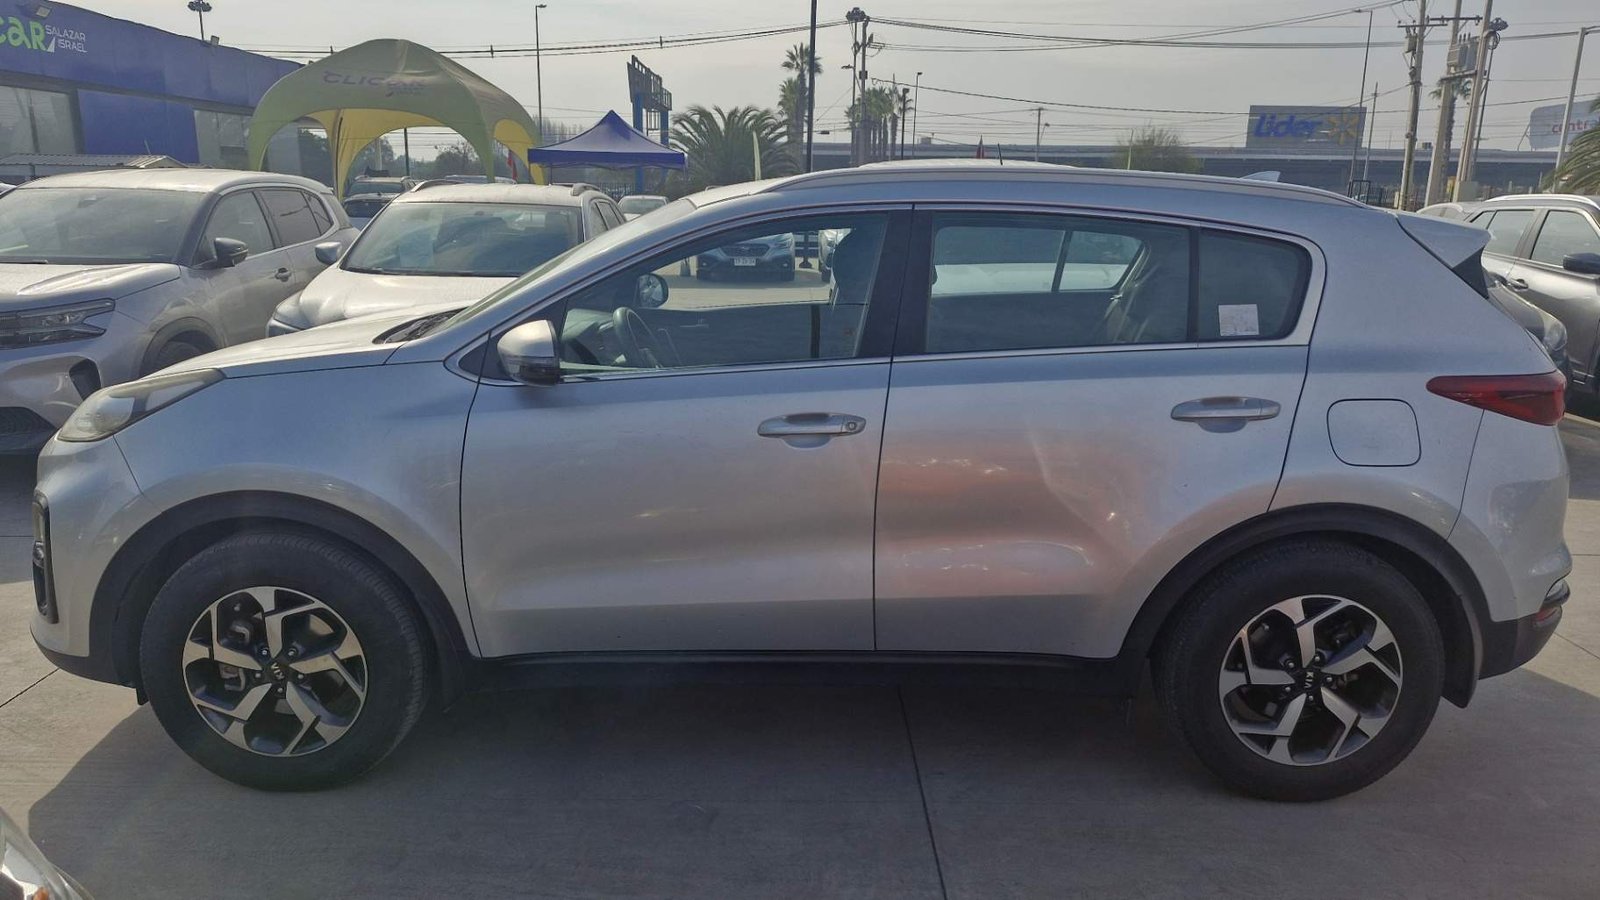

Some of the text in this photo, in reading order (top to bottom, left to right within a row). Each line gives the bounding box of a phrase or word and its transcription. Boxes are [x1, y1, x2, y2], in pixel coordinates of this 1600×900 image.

[45, 24, 86, 42] SALAZAR
[58, 38, 88, 53] ISRAEL
[271, 662, 285, 680] KIA
[1304, 671, 1314, 689] KIA
